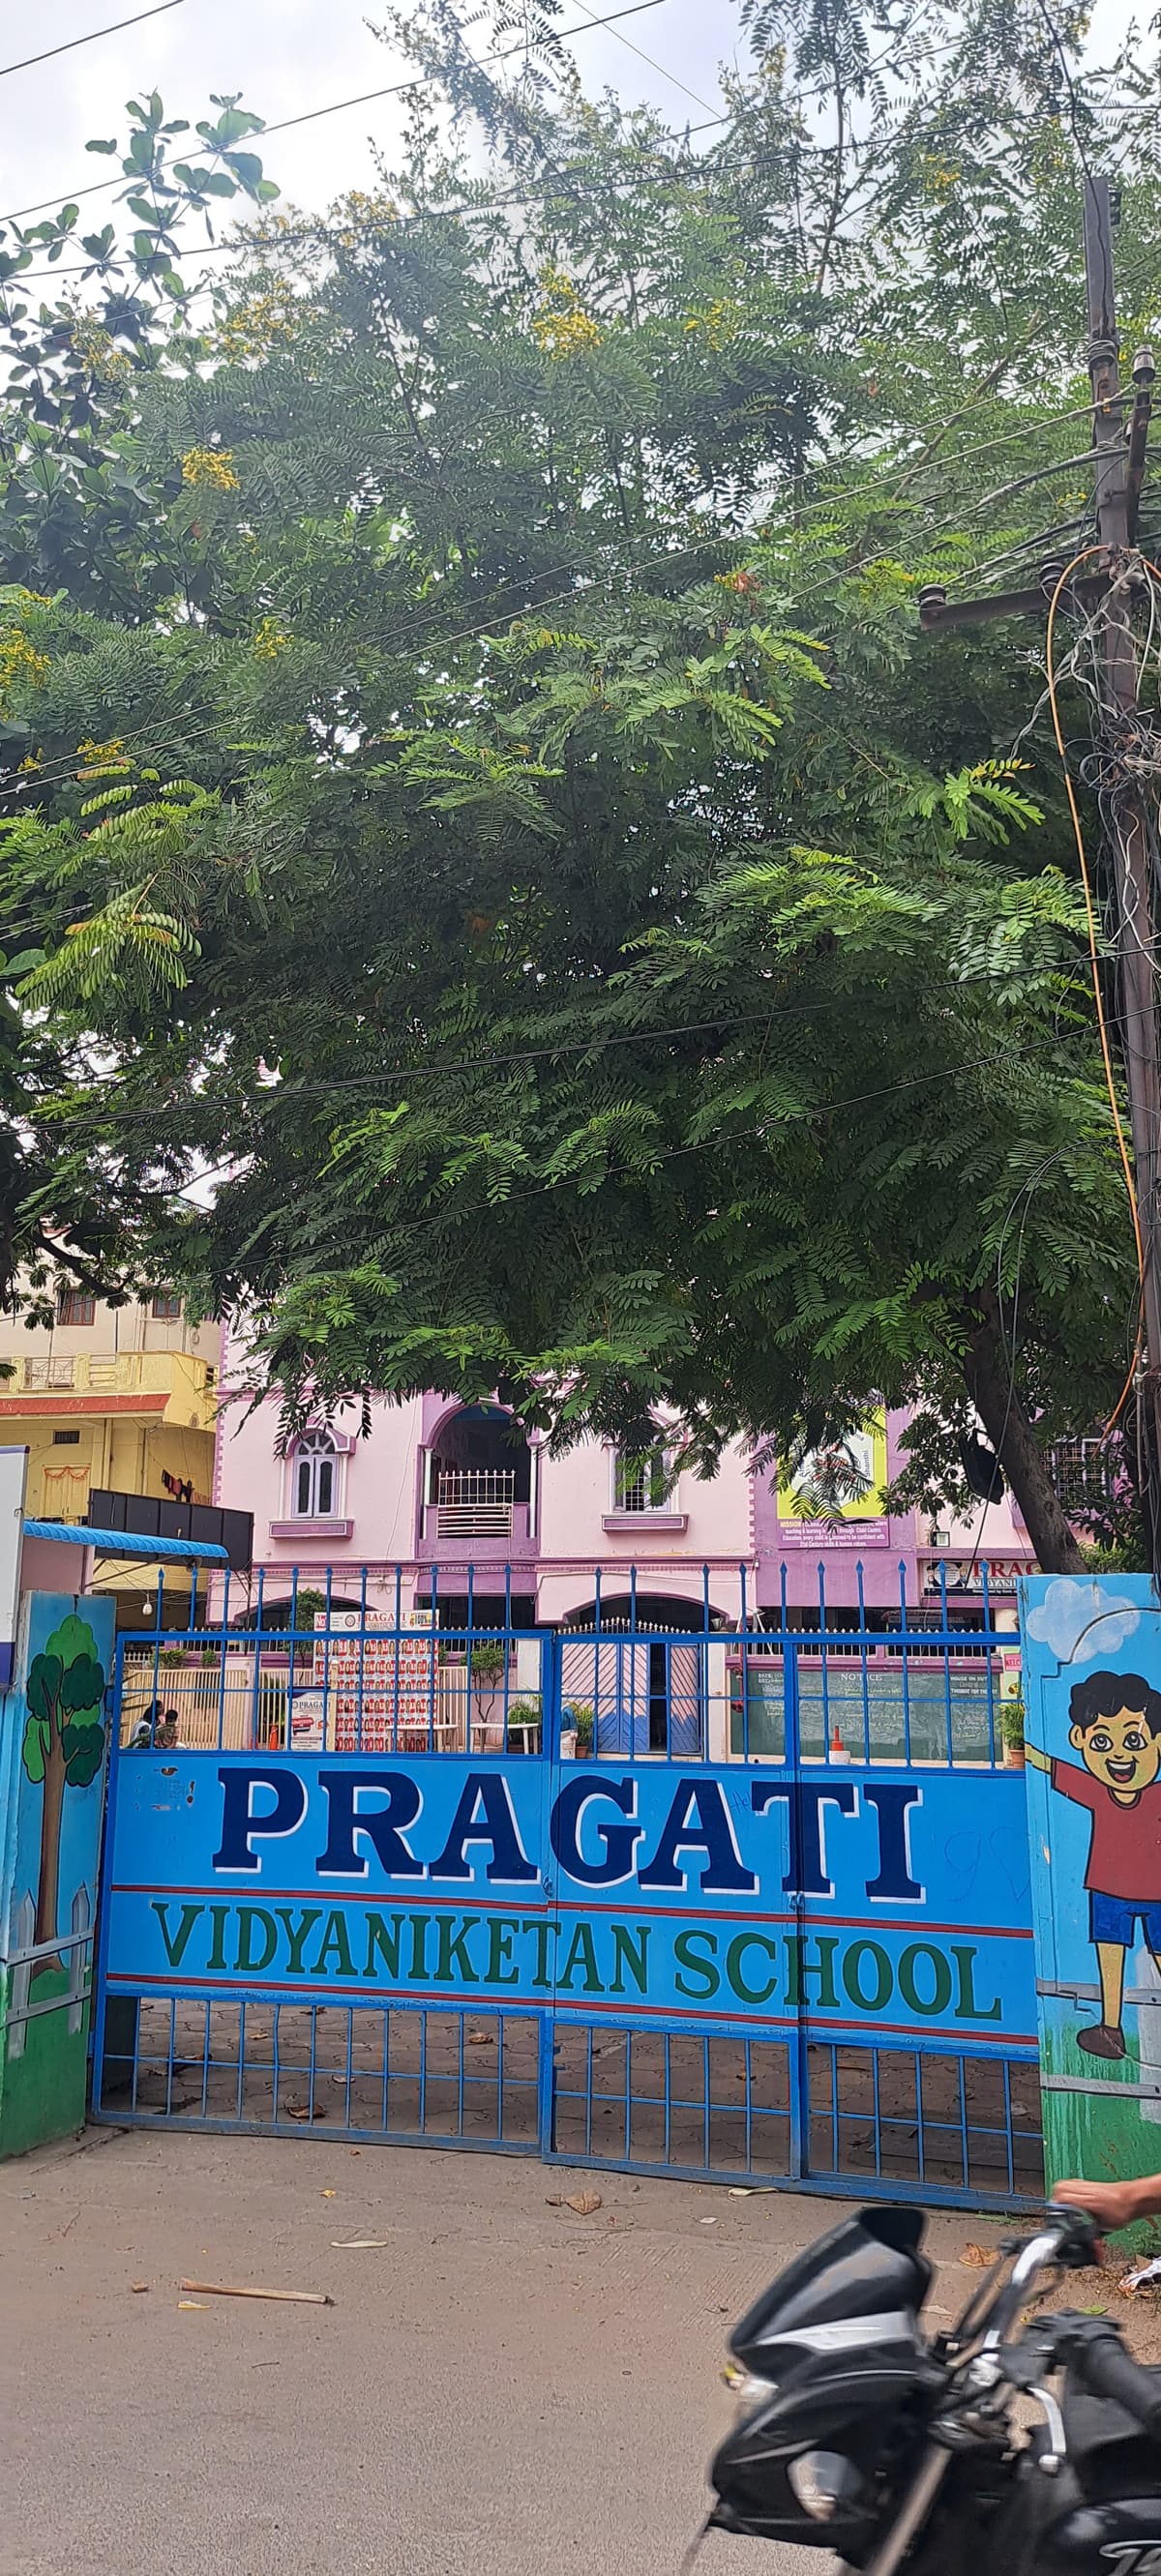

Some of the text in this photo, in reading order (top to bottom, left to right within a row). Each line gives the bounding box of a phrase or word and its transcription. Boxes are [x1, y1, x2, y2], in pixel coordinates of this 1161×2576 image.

[212, 1767, 926, 1904] PRAGATI
[151, 1902, 1002, 2021] VIDYANIKETAN SCHOOL
